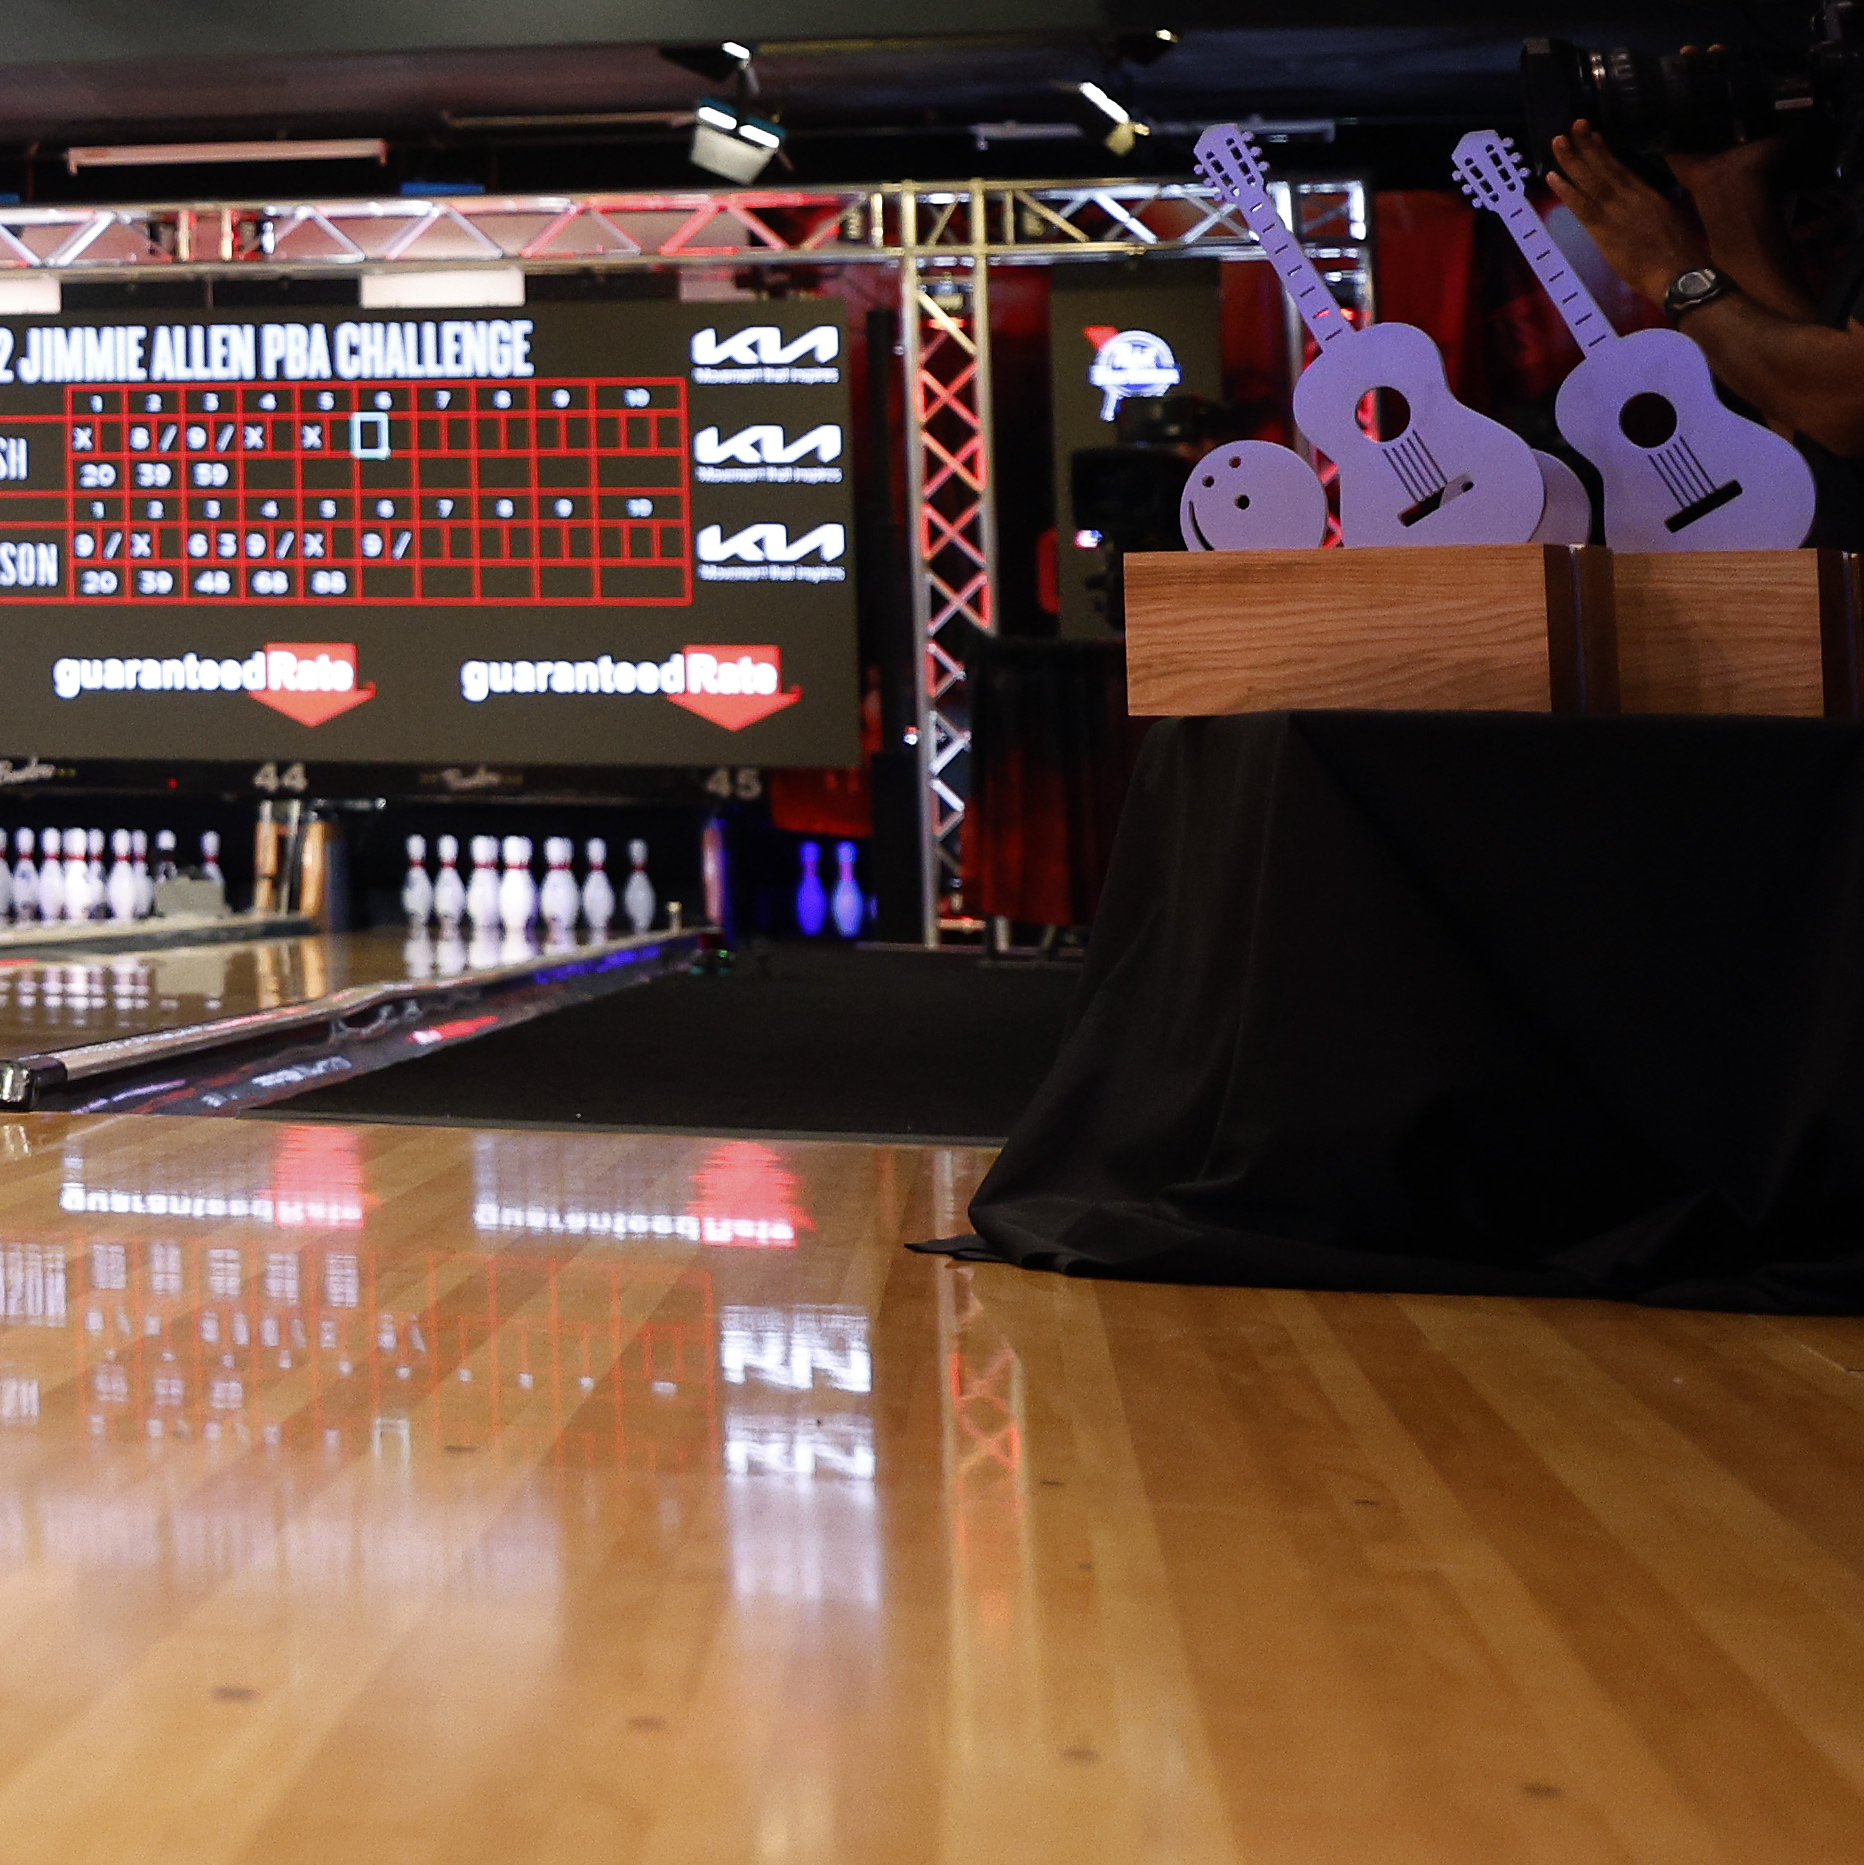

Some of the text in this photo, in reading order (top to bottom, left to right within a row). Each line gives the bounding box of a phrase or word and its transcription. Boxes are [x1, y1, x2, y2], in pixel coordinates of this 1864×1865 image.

[17, 324, 148, 383] JIMMIE
[149, 323, 257, 381] ALLEN
[260, 322, 333, 381] PBA
[334, 319, 535, 379] CHALLENGE
[90, 395, 103, 413] 1
[436, 390, 451, 410] 7
[73, 427, 93, 451] X
[244, 426, 264, 449] X
[302, 425, 322, 449] X
[80, 463, 117, 488] 20
[137, 463, 172, 487] 39
[92, 501, 105, 519] 1
[438, 499, 454, 518] 7
[130, 533, 152, 558] X
[304, 533, 325, 557] X
[82, 570, 118, 595] 20
[139, 570, 174, 595] 39
[253, 761, 307, 792] 44
[705, 765, 762, 800] 45
